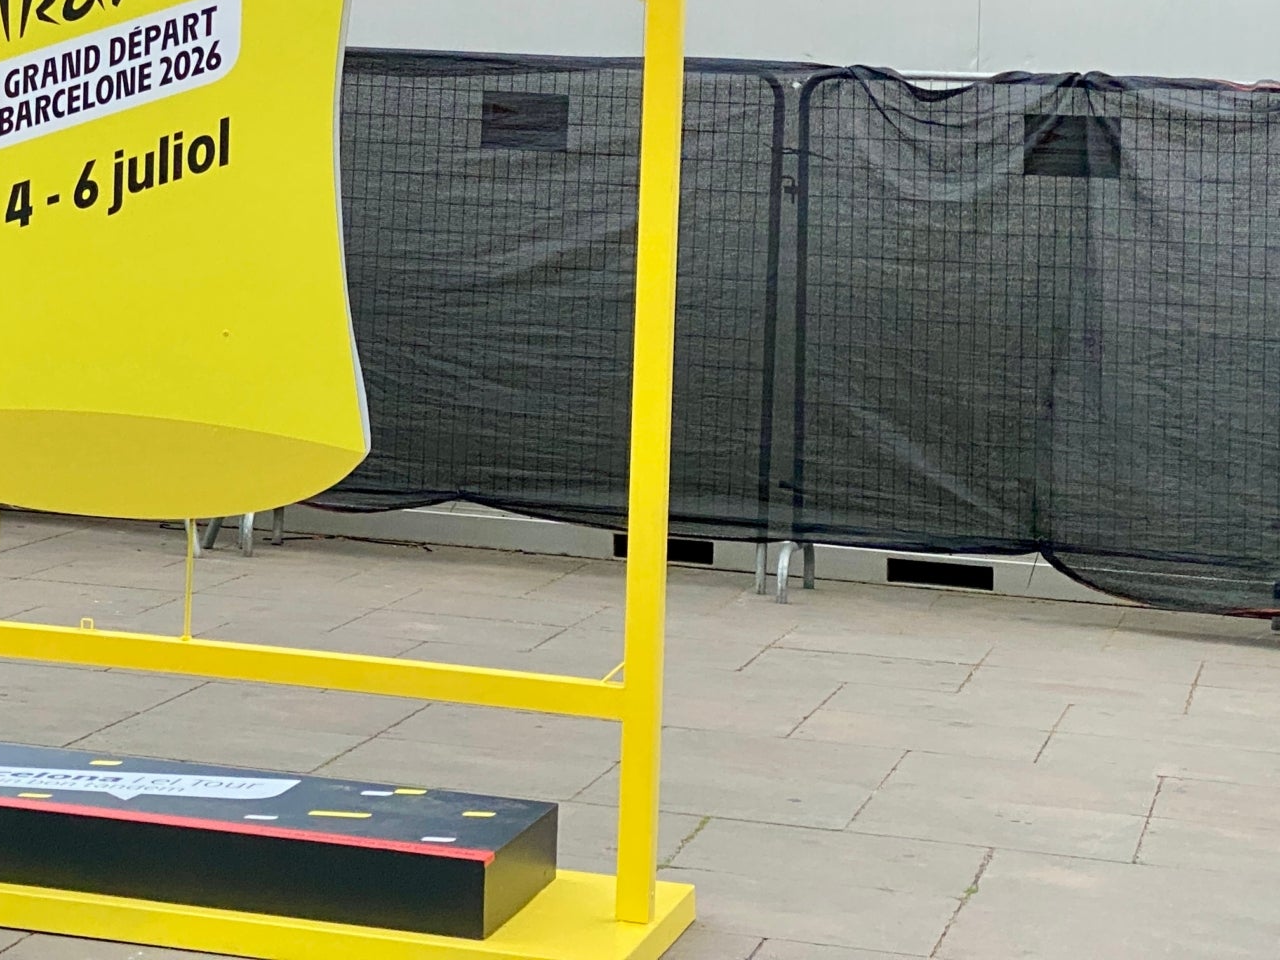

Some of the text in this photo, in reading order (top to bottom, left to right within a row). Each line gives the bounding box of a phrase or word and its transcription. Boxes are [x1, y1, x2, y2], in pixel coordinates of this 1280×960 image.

[4, 5, 218, 98] GRAND DÉPART
[159, 40, 222, 87] 2026
[5, 179, 33, 228] 4
[73, 159, 99, 209] 6
[107, 117, 230, 216] juliol
[151, 777, 183, 786] el
[194, 779, 265, 790] Tour
